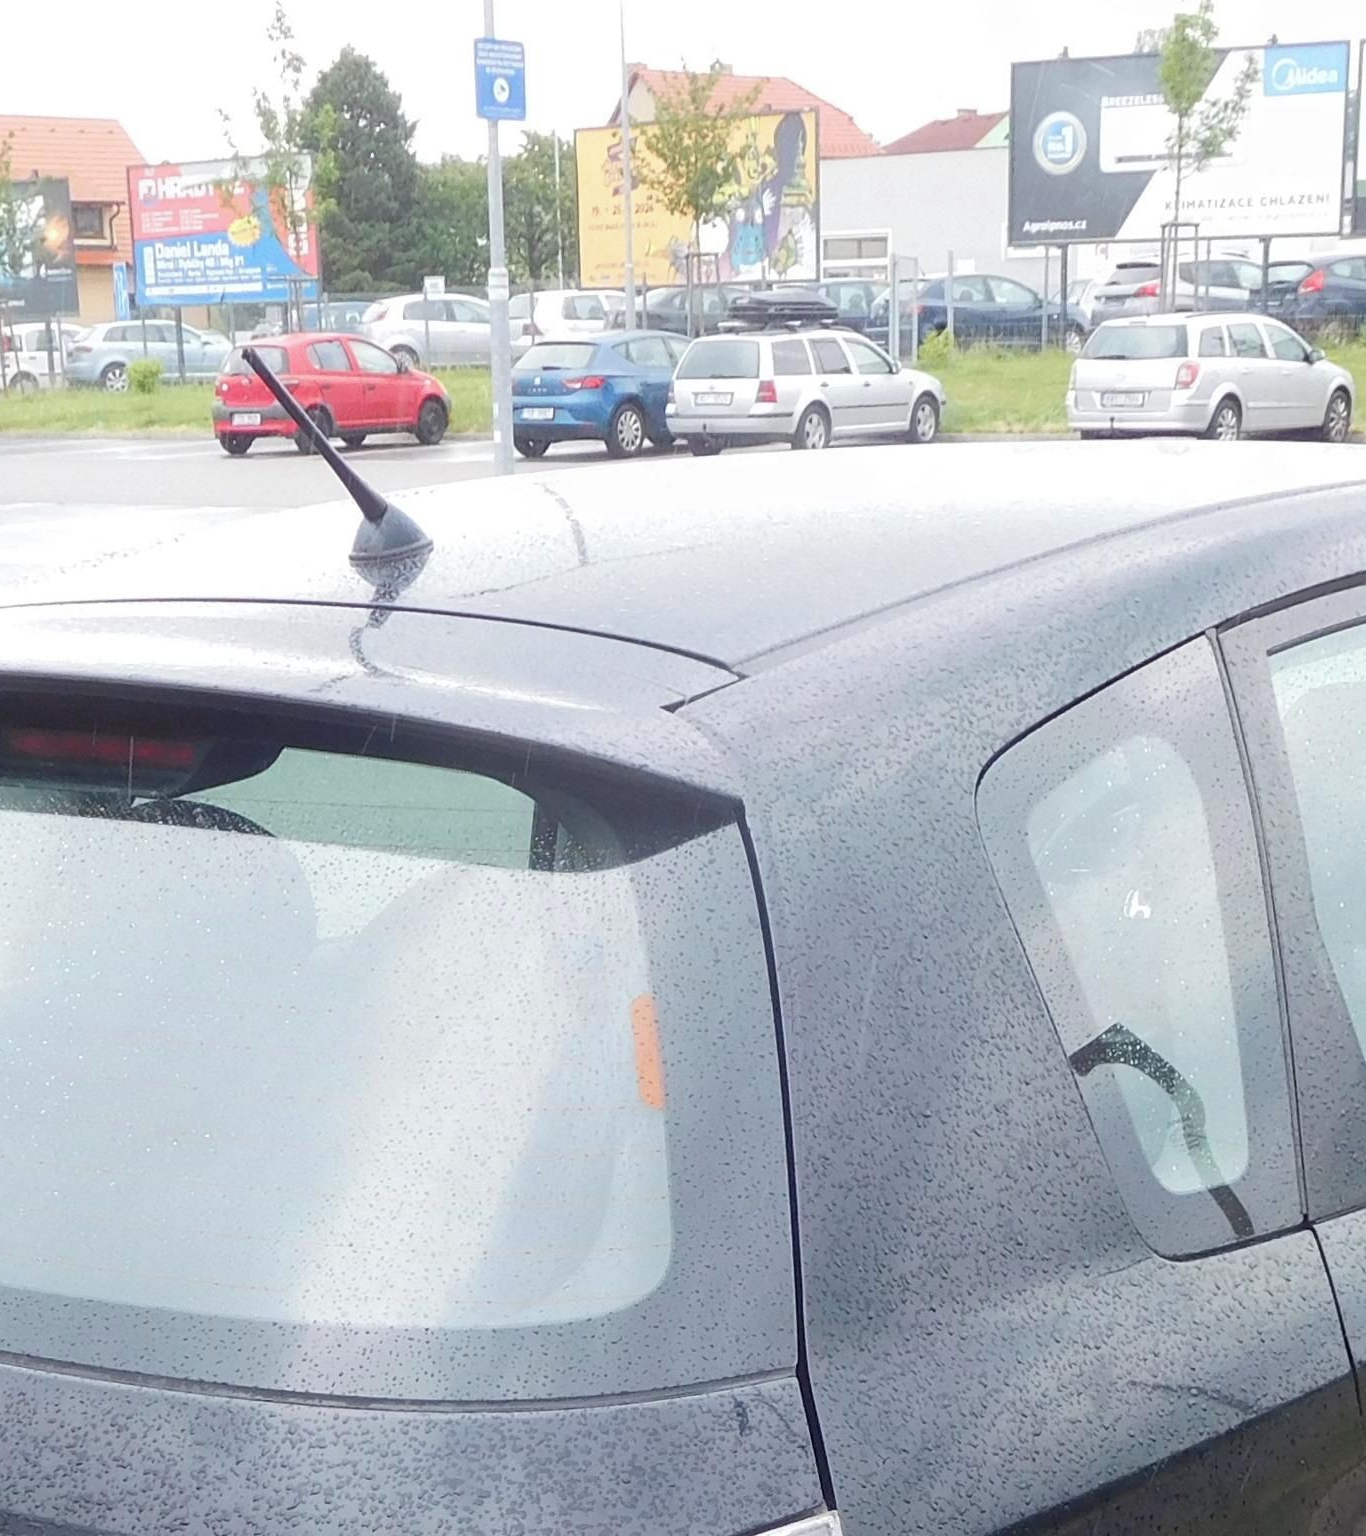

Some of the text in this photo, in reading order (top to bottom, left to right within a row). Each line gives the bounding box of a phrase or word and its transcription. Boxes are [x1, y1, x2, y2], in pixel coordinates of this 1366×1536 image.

[1164, 192, 1331, 210] KIMATIZACE CHLAZENÍ
[155, 238, 230, 259] Daniel Landa
